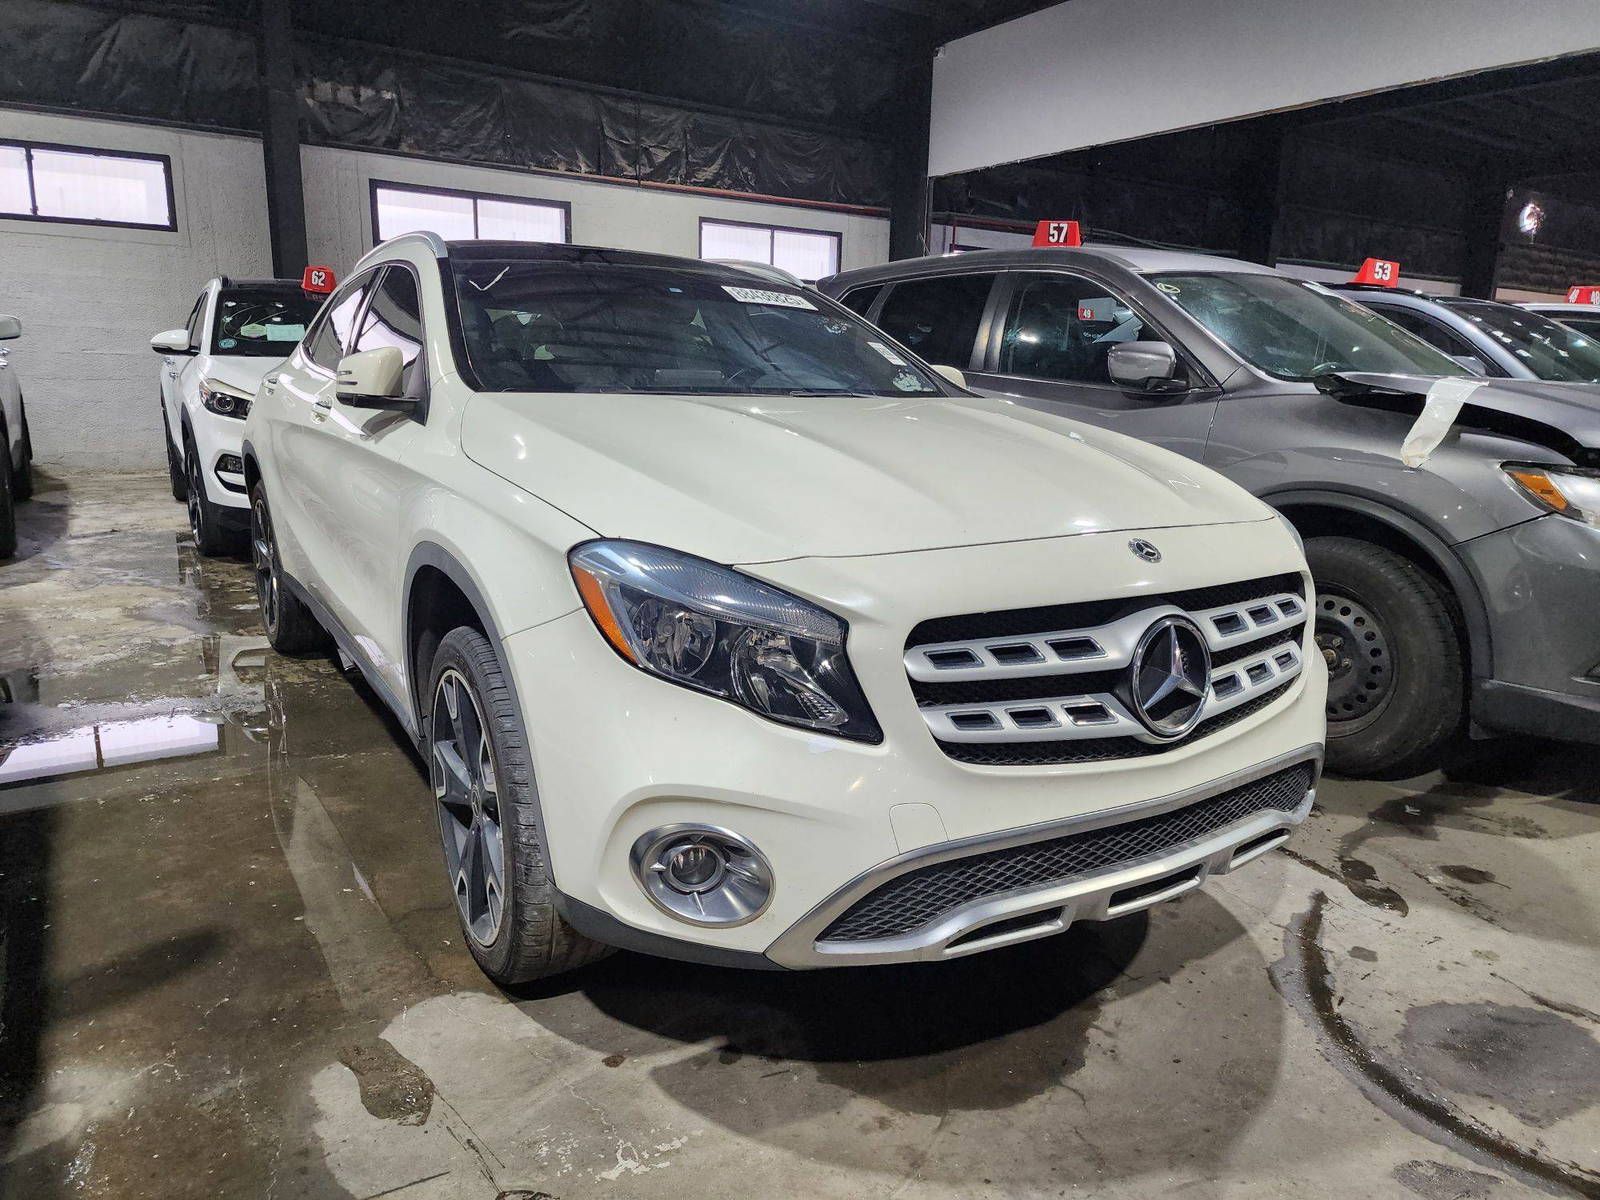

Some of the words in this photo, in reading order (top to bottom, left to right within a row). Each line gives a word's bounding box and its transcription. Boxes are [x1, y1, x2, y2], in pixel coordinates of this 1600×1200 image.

[1048, 222, 1068, 243] 57
[311, 270, 326, 287] 62
[1374, 261, 1392, 281] 53
